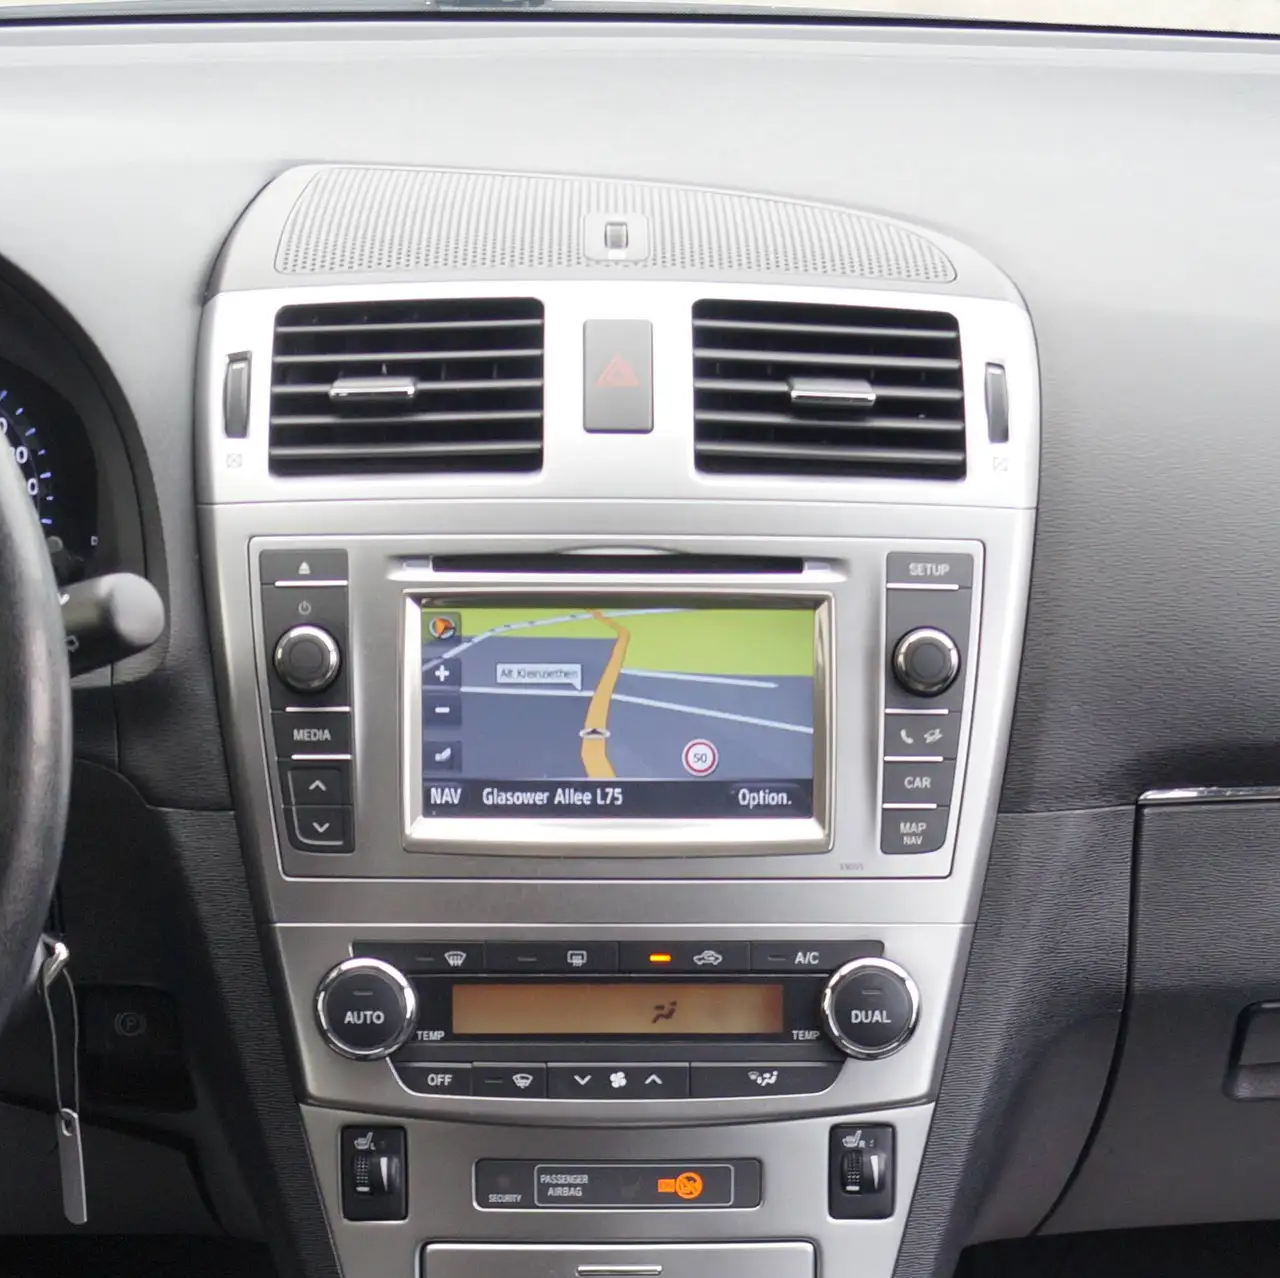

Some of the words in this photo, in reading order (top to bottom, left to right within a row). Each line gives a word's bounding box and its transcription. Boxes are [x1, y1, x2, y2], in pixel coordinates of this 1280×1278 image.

[909, 563, 950, 578] SETUP
[293, 727, 331, 742] MEDIA
[693, 752, 707, 764] 50
[904, 776, 931, 789] CAR
[430, 788, 461, 806] NAV
[482, 788, 550, 806] Glasower
[554, 788, 592, 806] Allee
[596, 788, 623, 806] L75
[738, 788, 792, 810] Option.
[900, 821, 927, 835] MAP
[903, 835, 923, 846] NAV
[794, 951, 820, 965] A/C
[344, 1010, 385, 1025] AUTO
[850, 1010, 891, 1024] DUAL
[416, 1030, 445, 1041] TEMP
[791, 1029, 820, 1041] TEMP
[427, 1073, 453, 1087] OFF
[539, 1174, 589, 1185] PASSENGER
[547, 1186, 583, 1197] AIRBAG
